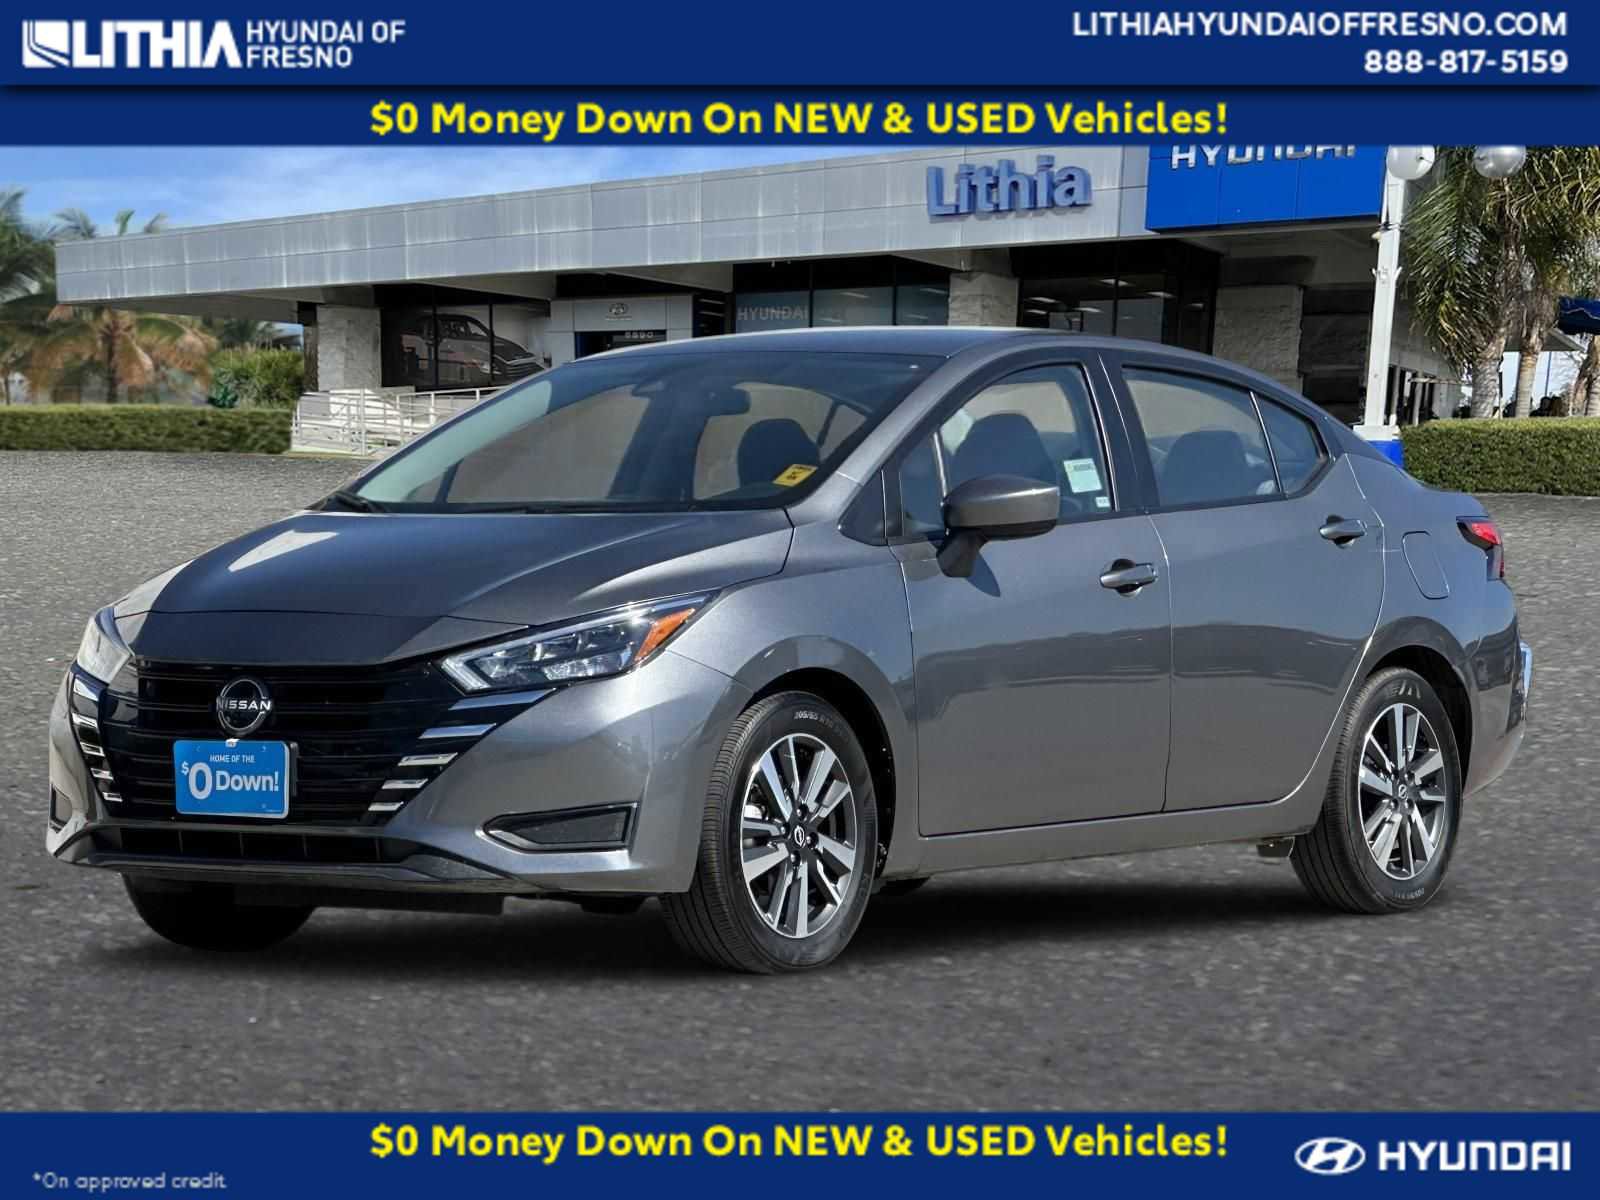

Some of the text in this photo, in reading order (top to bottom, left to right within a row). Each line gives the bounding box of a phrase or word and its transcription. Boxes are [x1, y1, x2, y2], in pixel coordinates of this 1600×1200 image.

[926, 155, 1093, 217] Lithia
[736, 304, 809, 321] HYUNDAI
[216, 698, 271, 711] NISSAN
[210, 754, 256, 763] HOME OF THE
[215, 770, 279, 792] Down!
